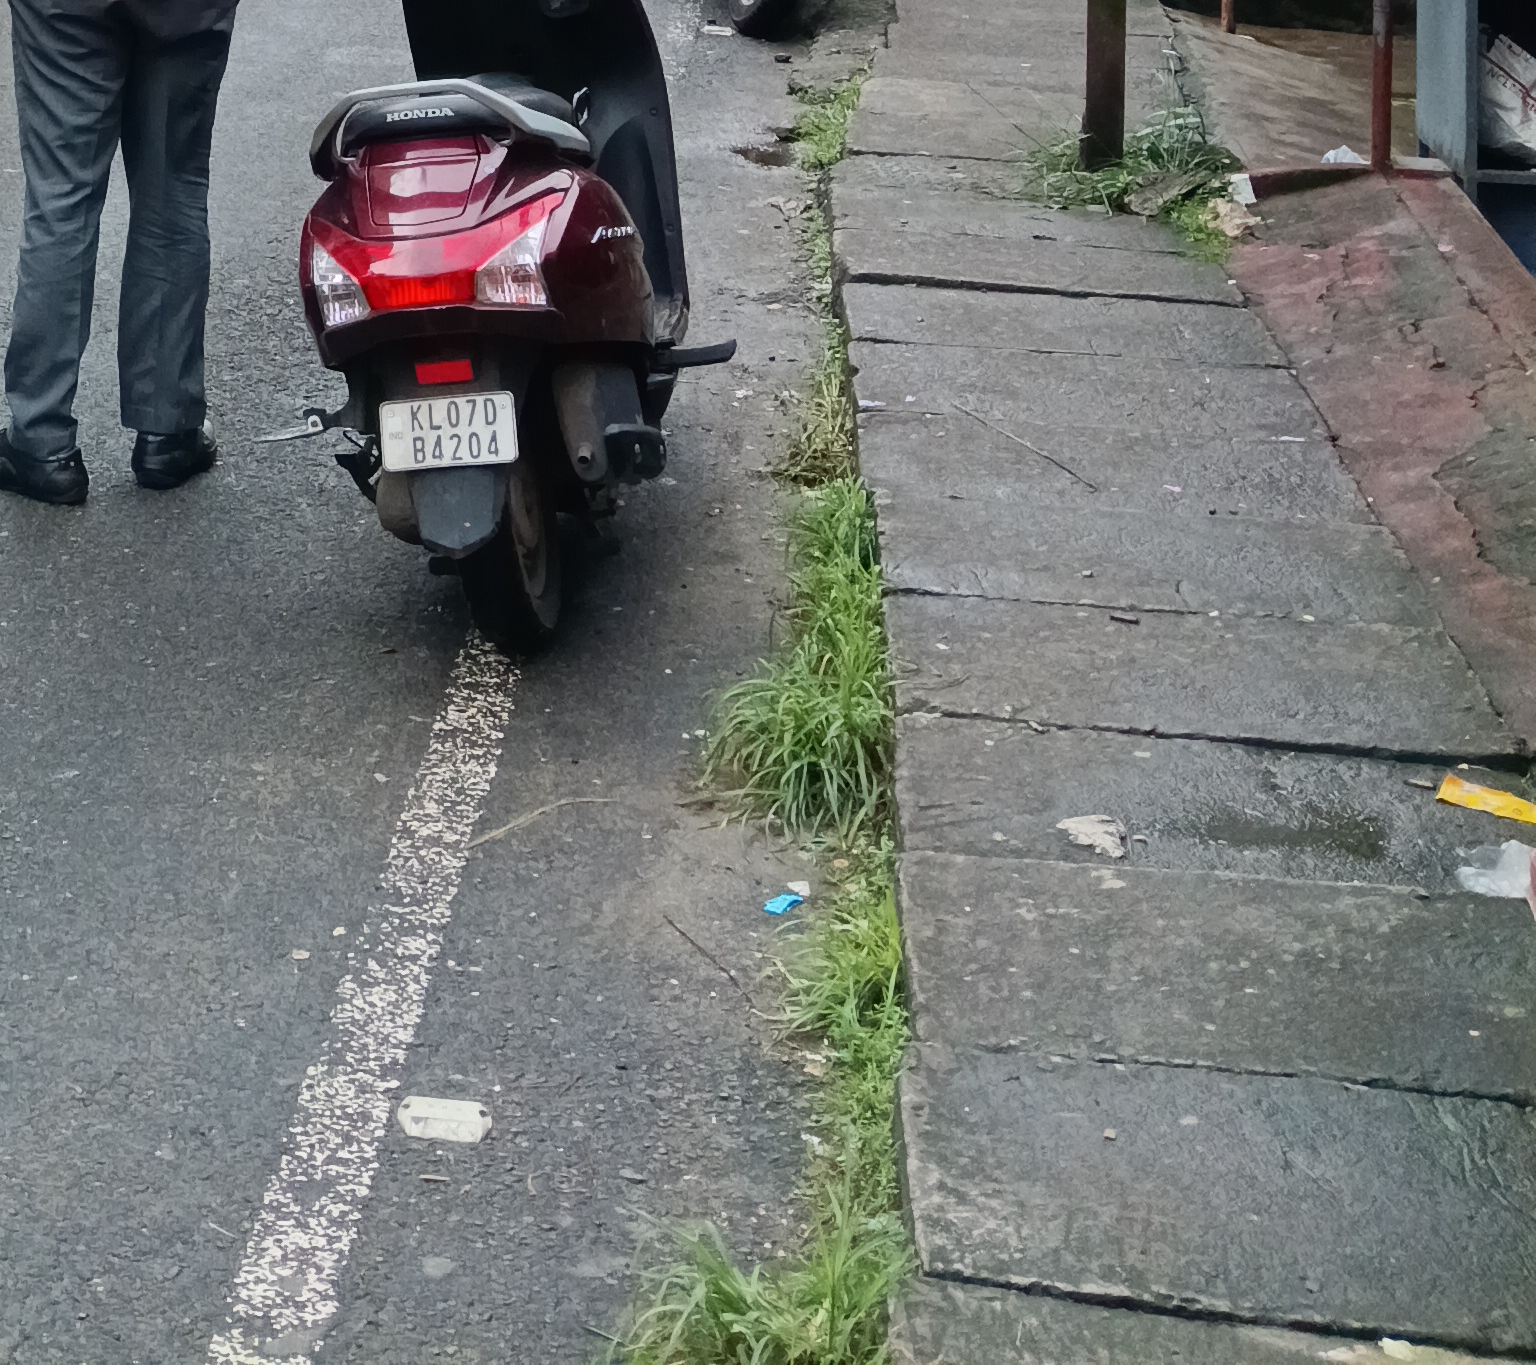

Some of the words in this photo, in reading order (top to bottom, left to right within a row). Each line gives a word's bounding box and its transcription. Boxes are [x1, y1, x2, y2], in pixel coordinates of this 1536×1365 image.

[386, 107, 455, 122] HONDA
[410, 397, 499, 433] KL07D
[412, 429, 501, 465] B4204
